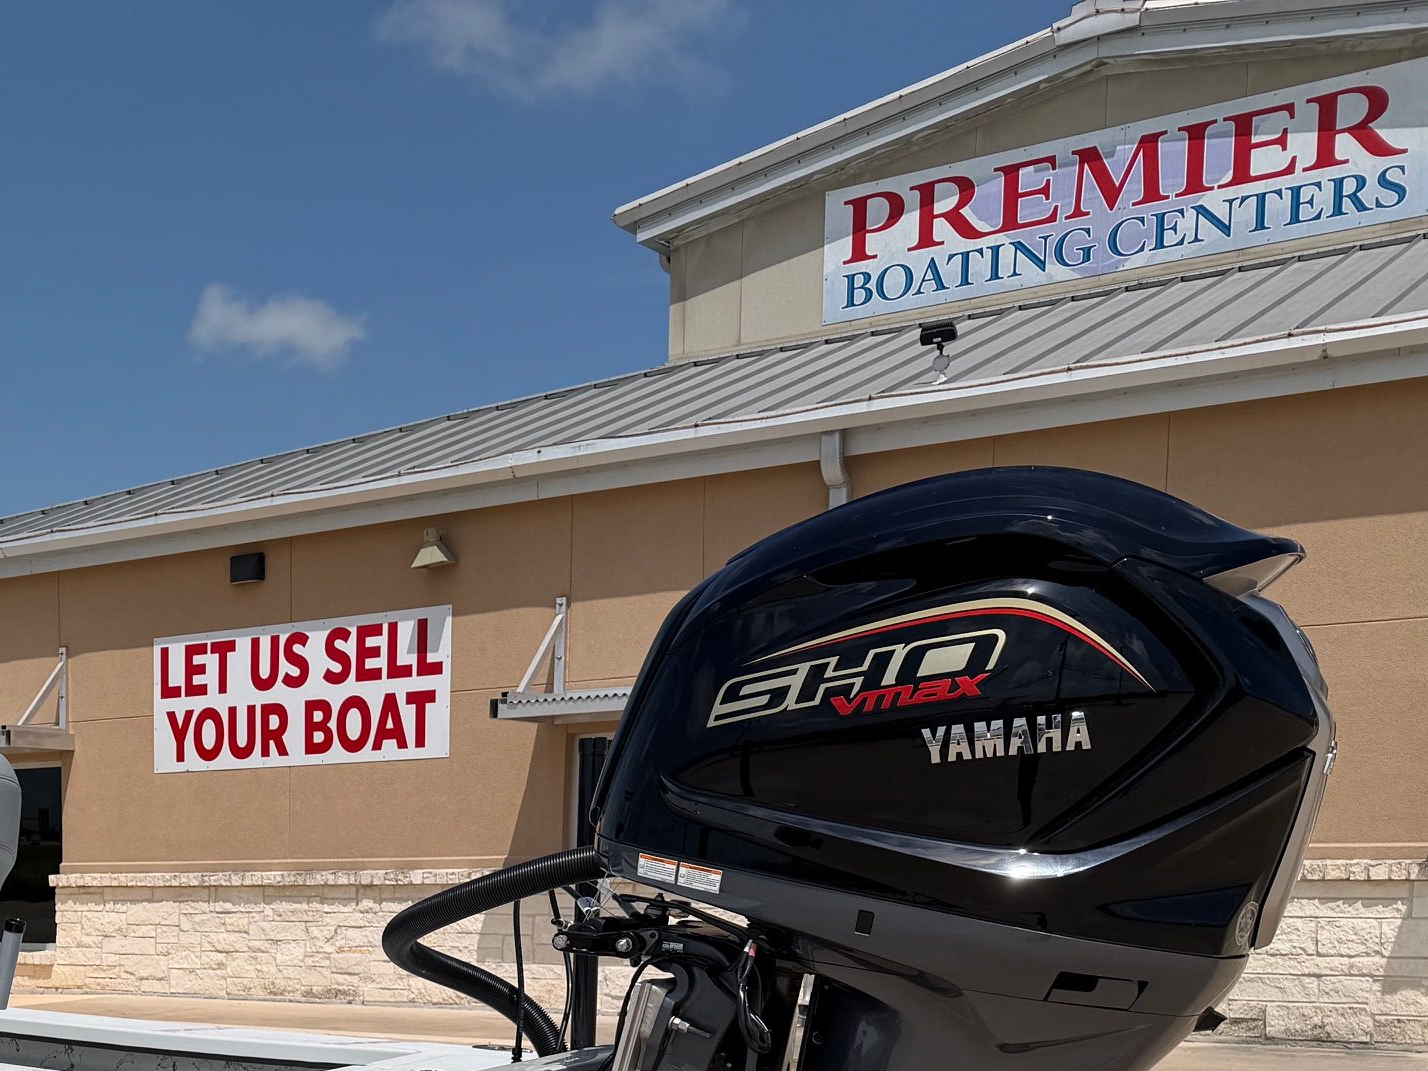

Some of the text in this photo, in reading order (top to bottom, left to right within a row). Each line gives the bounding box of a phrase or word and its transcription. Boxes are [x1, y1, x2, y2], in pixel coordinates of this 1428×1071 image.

[843, 84, 1409, 265] PREMIER
[841, 165, 1408, 310] BOATING CENTERS
[160, 617, 444, 699] LET US SELL
[706, 628, 1007, 728] SHO
[166, 689, 436, 763] YOUR BOAT
[920, 710, 1092, 765] YAMAHA
